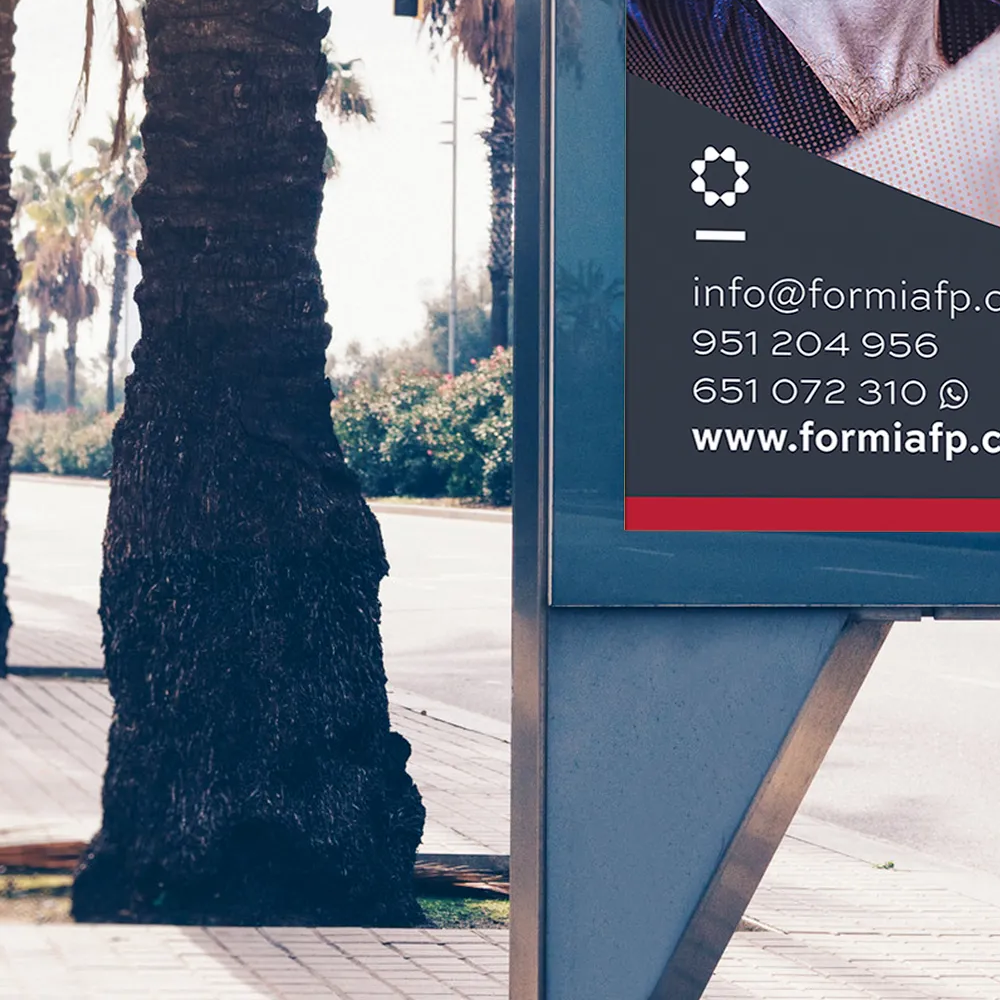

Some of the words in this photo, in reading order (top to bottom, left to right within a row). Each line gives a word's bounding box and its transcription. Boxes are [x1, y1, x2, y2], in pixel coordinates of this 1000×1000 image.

[692, 329, 758, 356] 951
[771, 330, 850, 357] 204
[861, 332, 939, 359] 956
[692, 377, 758, 404] 651
[771, 378, 846, 405] 072
[857, 379, 927, 406] 310
